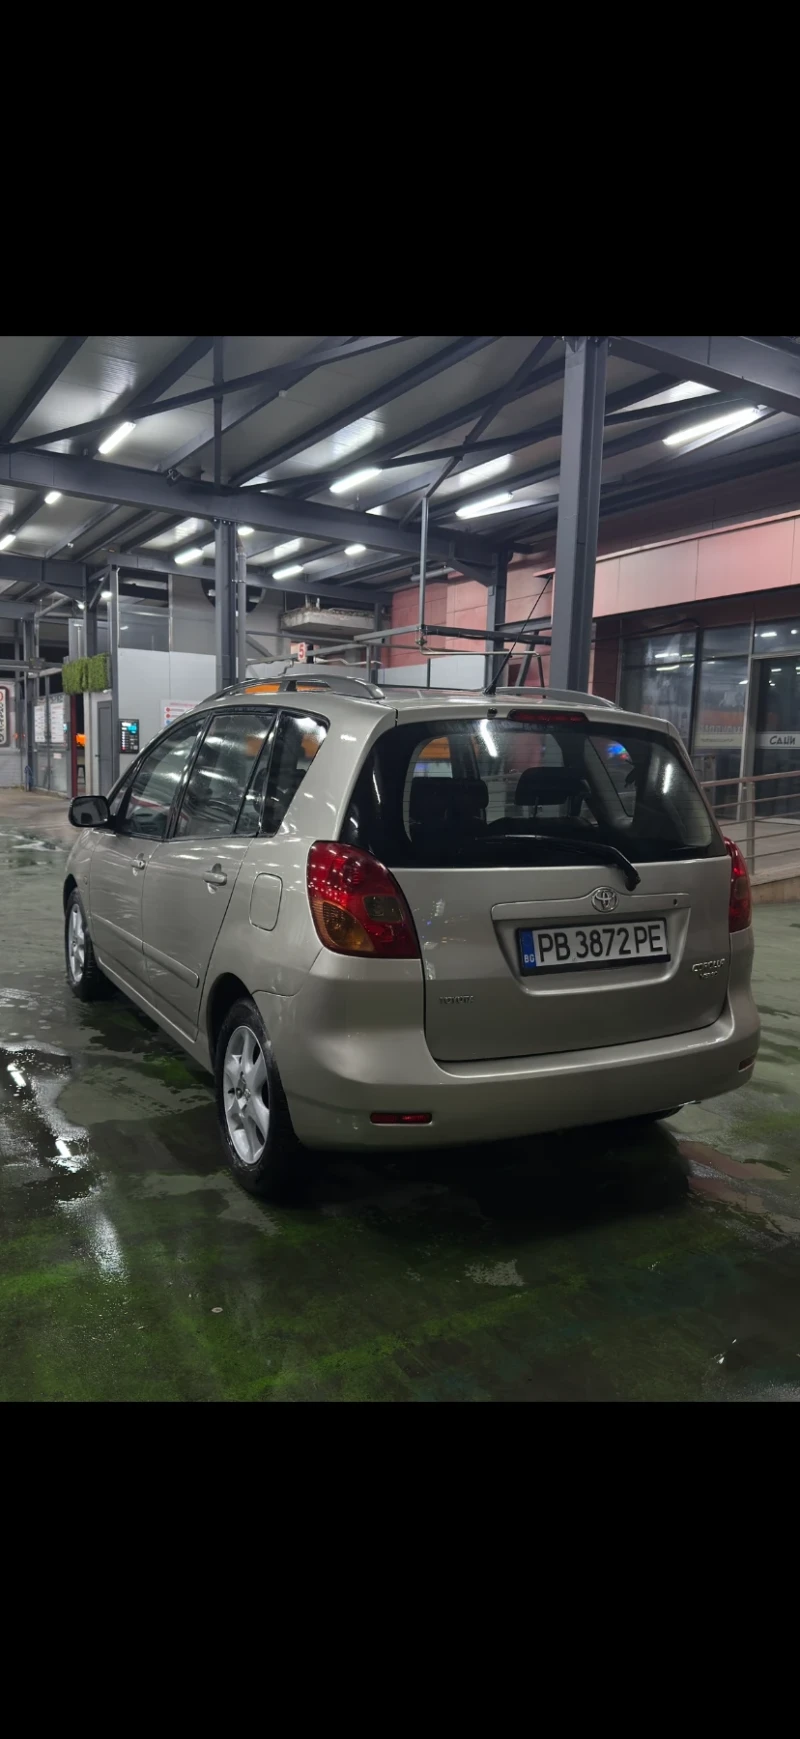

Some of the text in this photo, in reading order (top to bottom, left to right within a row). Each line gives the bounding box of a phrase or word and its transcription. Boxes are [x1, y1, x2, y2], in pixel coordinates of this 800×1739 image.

[537, 924, 664, 963] PB 3872 PE
[524, 954, 535, 963] BG
